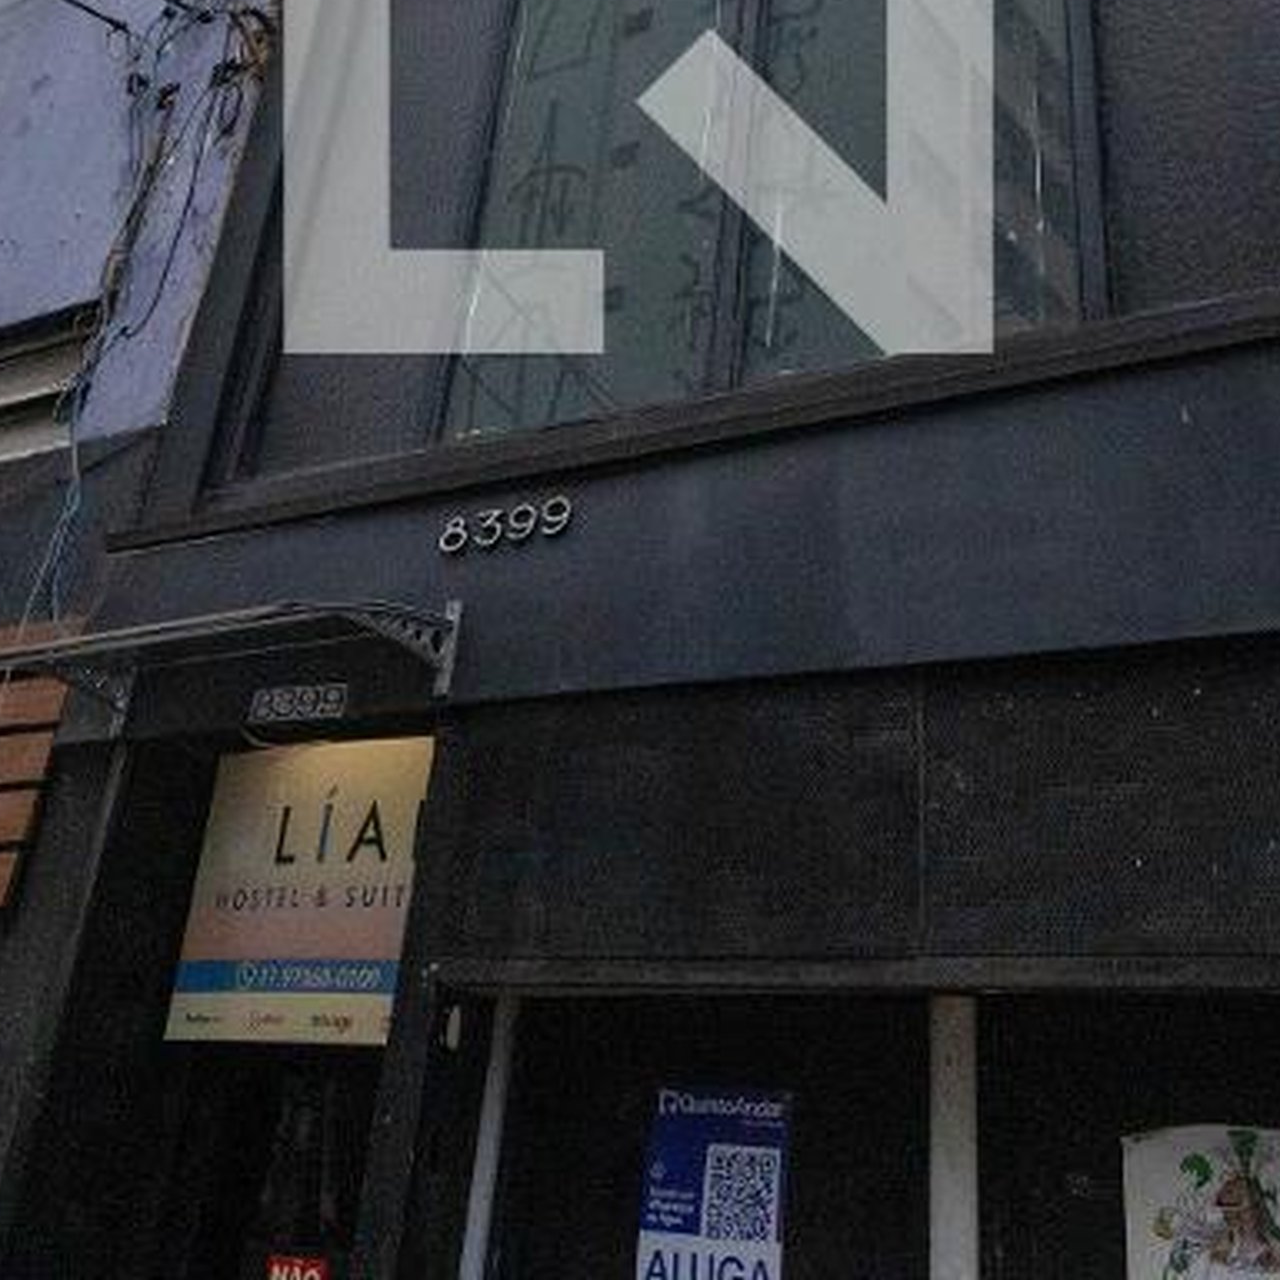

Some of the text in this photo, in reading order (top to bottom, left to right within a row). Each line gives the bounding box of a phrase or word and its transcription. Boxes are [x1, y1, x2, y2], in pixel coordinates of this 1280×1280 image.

[438, 496, 571, 552] 8399
[275, 785, 425, 864] LÍA
[216, 885, 299, 911] HOSTEL
